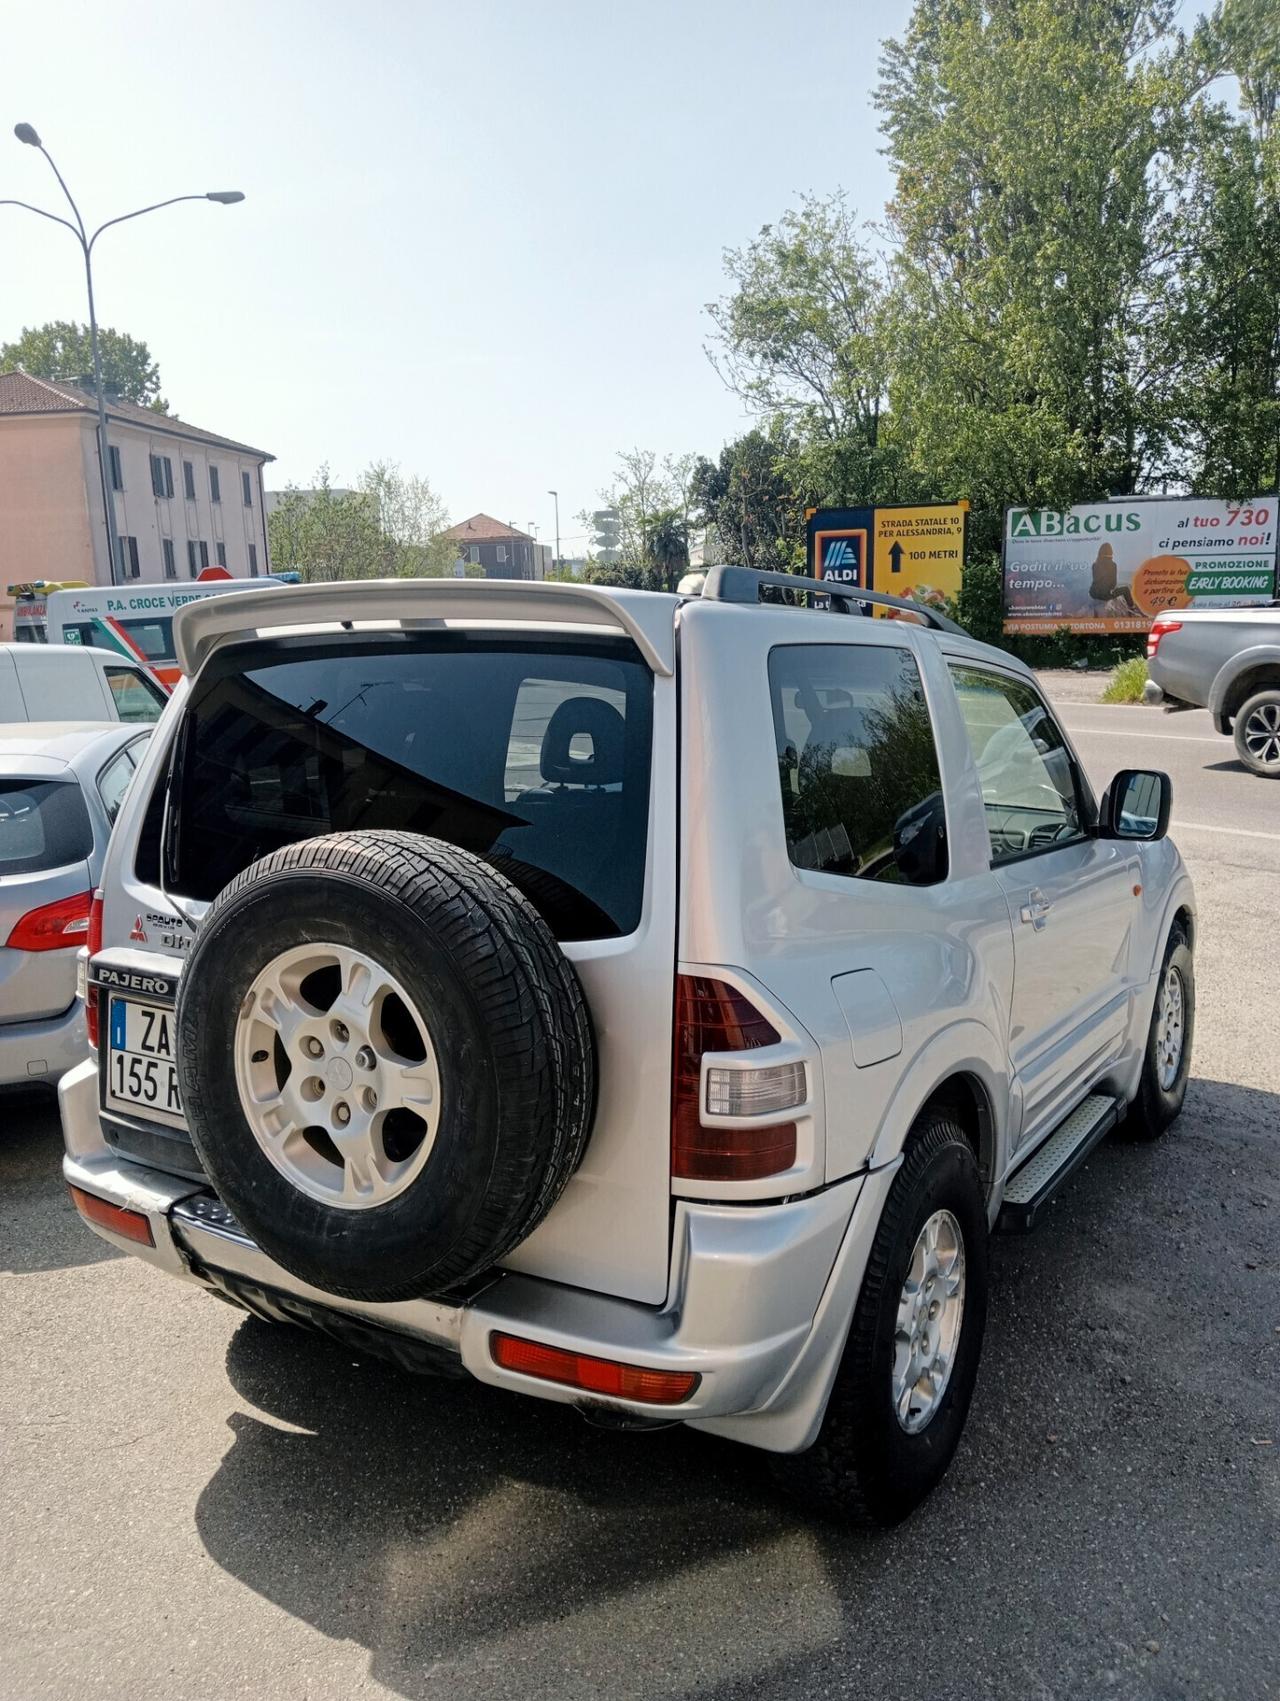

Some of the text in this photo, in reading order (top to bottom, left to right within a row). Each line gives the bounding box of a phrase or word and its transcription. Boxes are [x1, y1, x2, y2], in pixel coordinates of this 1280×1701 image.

[881, 517, 960, 528] STRADA STATALE 10
[1177, 509, 1269, 528] al tuo 730
[879, 527, 962, 538] PER ALESSANDRIA, 9
[1159, 532, 1272, 551] ci pensiamo noi!
[909, 550, 958, 560] 100 METRI
[1195, 559, 1270, 570] PROMOZIONE
[824, 569, 858, 581] ALDI
[1009, 578, 1065, 592] tempo...
[1189, 575, 1269, 589] EARLY BOOKING
[107, 600, 127, 611] P.A.
[129, 597, 166, 609] CROCE
[814, 601, 824, 609] La
[1150, 595, 1178, 607] 49 €
[1007, 624, 1019, 632] VIA
[1021, 623, 1059, 631] POSTUMIA
[1069, 622, 1106, 631] TORTONA
[99, 968, 169, 994] PAJERO
[141, 1010, 171, 1056] ZA
[116, 1054, 182, 1110] 155 R
